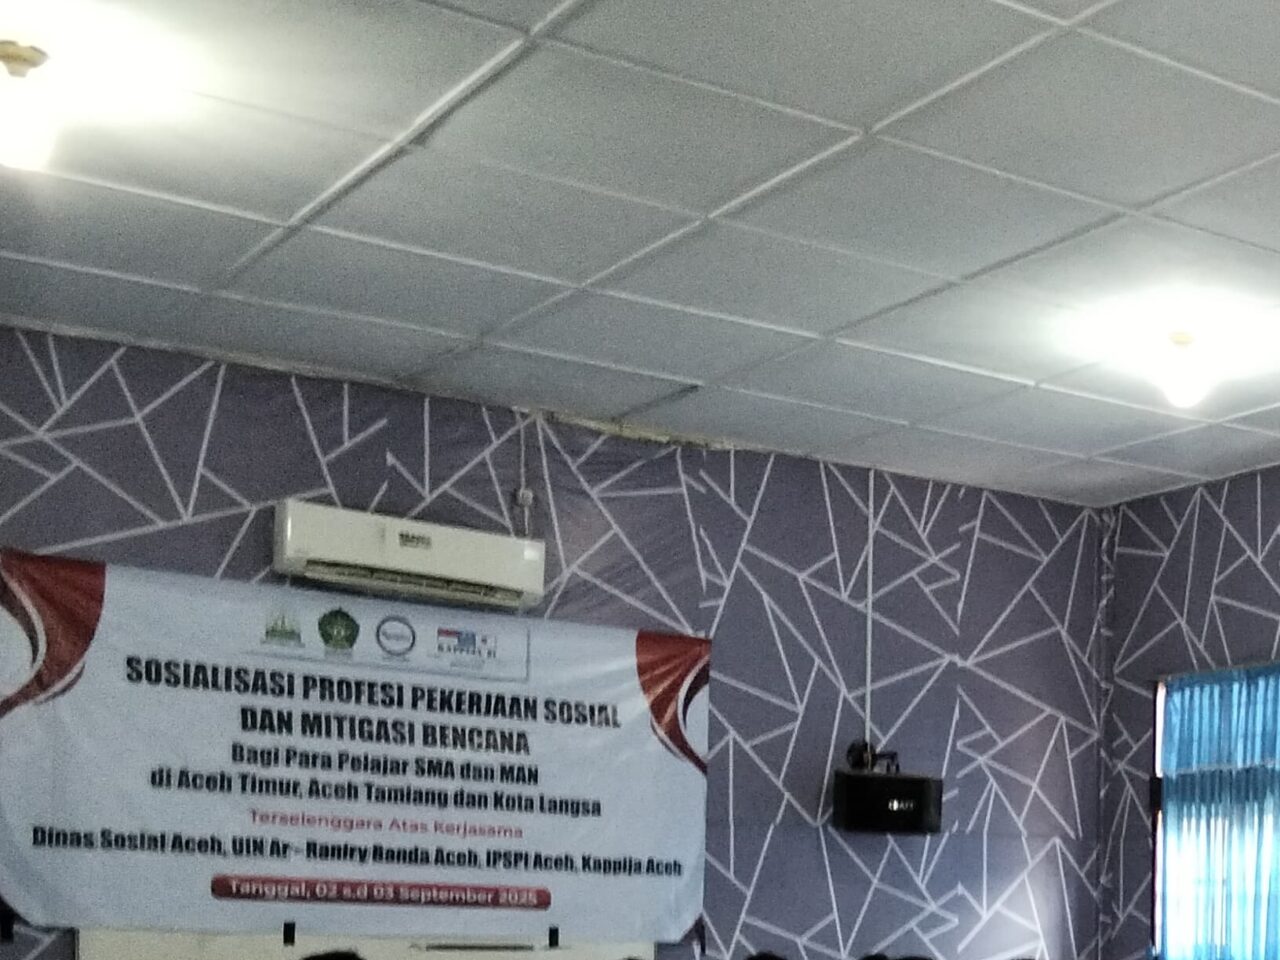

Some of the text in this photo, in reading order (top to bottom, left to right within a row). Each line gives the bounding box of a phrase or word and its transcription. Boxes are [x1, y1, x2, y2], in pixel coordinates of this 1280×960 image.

[126, 655, 622, 729] SOSIALISASI PROFESI PEKERJAAN SOSIAL
[240, 705, 531, 756] DAN MITIGASI BENCANA
[231, 742, 539, 786] Bagi Para Pelajar SMA dan MAN
[150, 767, 172, 789] di
[177, 768, 233, 794] Aceh
[308, 777, 359, 801] Aceh
[364, 782, 448, 811] Tamiang
[453, 786, 488, 811] dan
[493, 790, 535, 814] Kota
[539, 792, 602, 819] Langsa
[251, 808, 524, 840] Terselenggara Atas Kerjasama
[32, 825, 96, 849] Dinas
[100, 827, 166, 852] Sosial
[231, 834, 265, 857] UIN
[269, 837, 289, 859] Ar
[305, 840, 368, 864] Raniry
[372, 843, 430, 866] Banda
[486, 848, 530, 871] IPSPI
[582, 853, 642, 877] Kappija
[646, 856, 683, 878] Aceh
[400, 886, 495, 904] September
